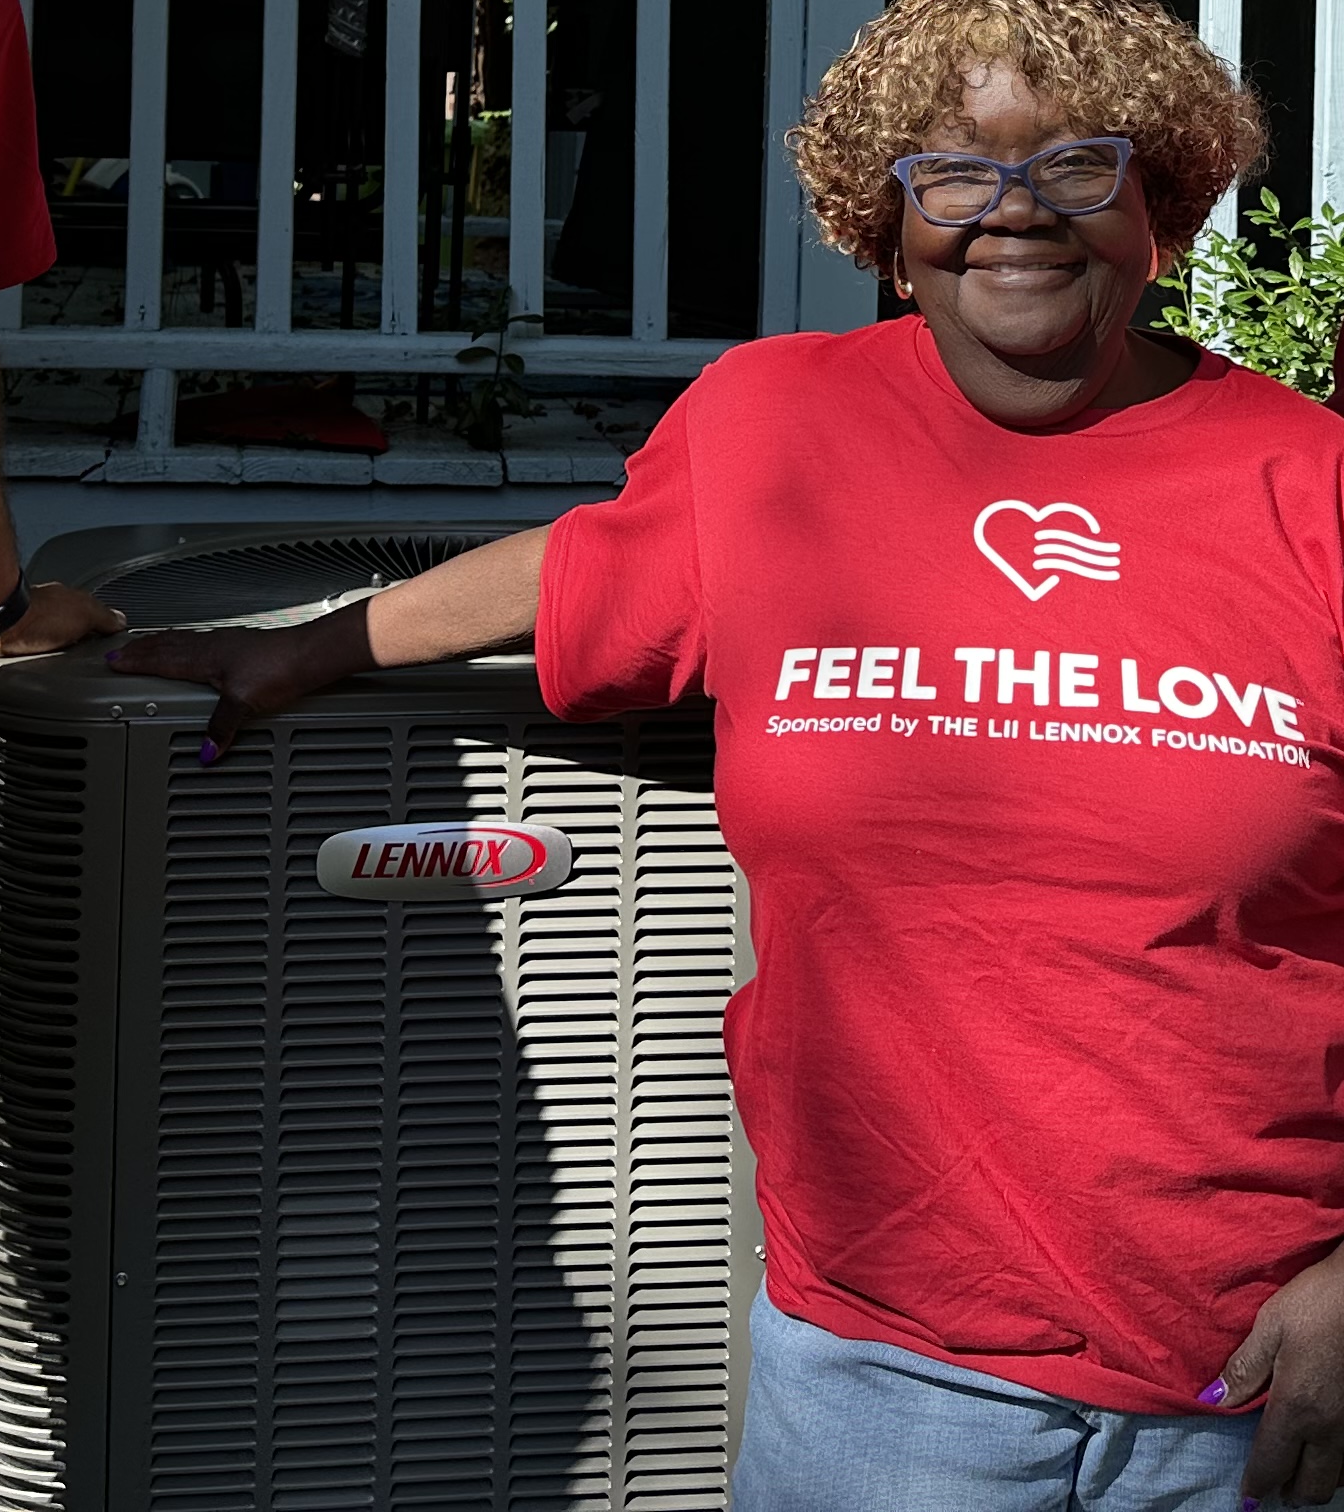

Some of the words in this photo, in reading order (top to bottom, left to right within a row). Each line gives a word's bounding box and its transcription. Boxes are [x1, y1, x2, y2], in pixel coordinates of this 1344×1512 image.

[774, 646, 937, 702] FEEL
[954, 647, 1099, 708] THE
[1120, 658, 1306, 742] LOVE
[765, 713, 882, 738] Sponsored
[890, 713, 920, 738] by
[927, 715, 979, 737] THE
[987, 718, 1019, 739] LII
[1029, 719, 1142, 745] LENNOX
[1151, 728, 1311, 770] FOUNDATION
[351, 839, 512, 879] LENNOX
